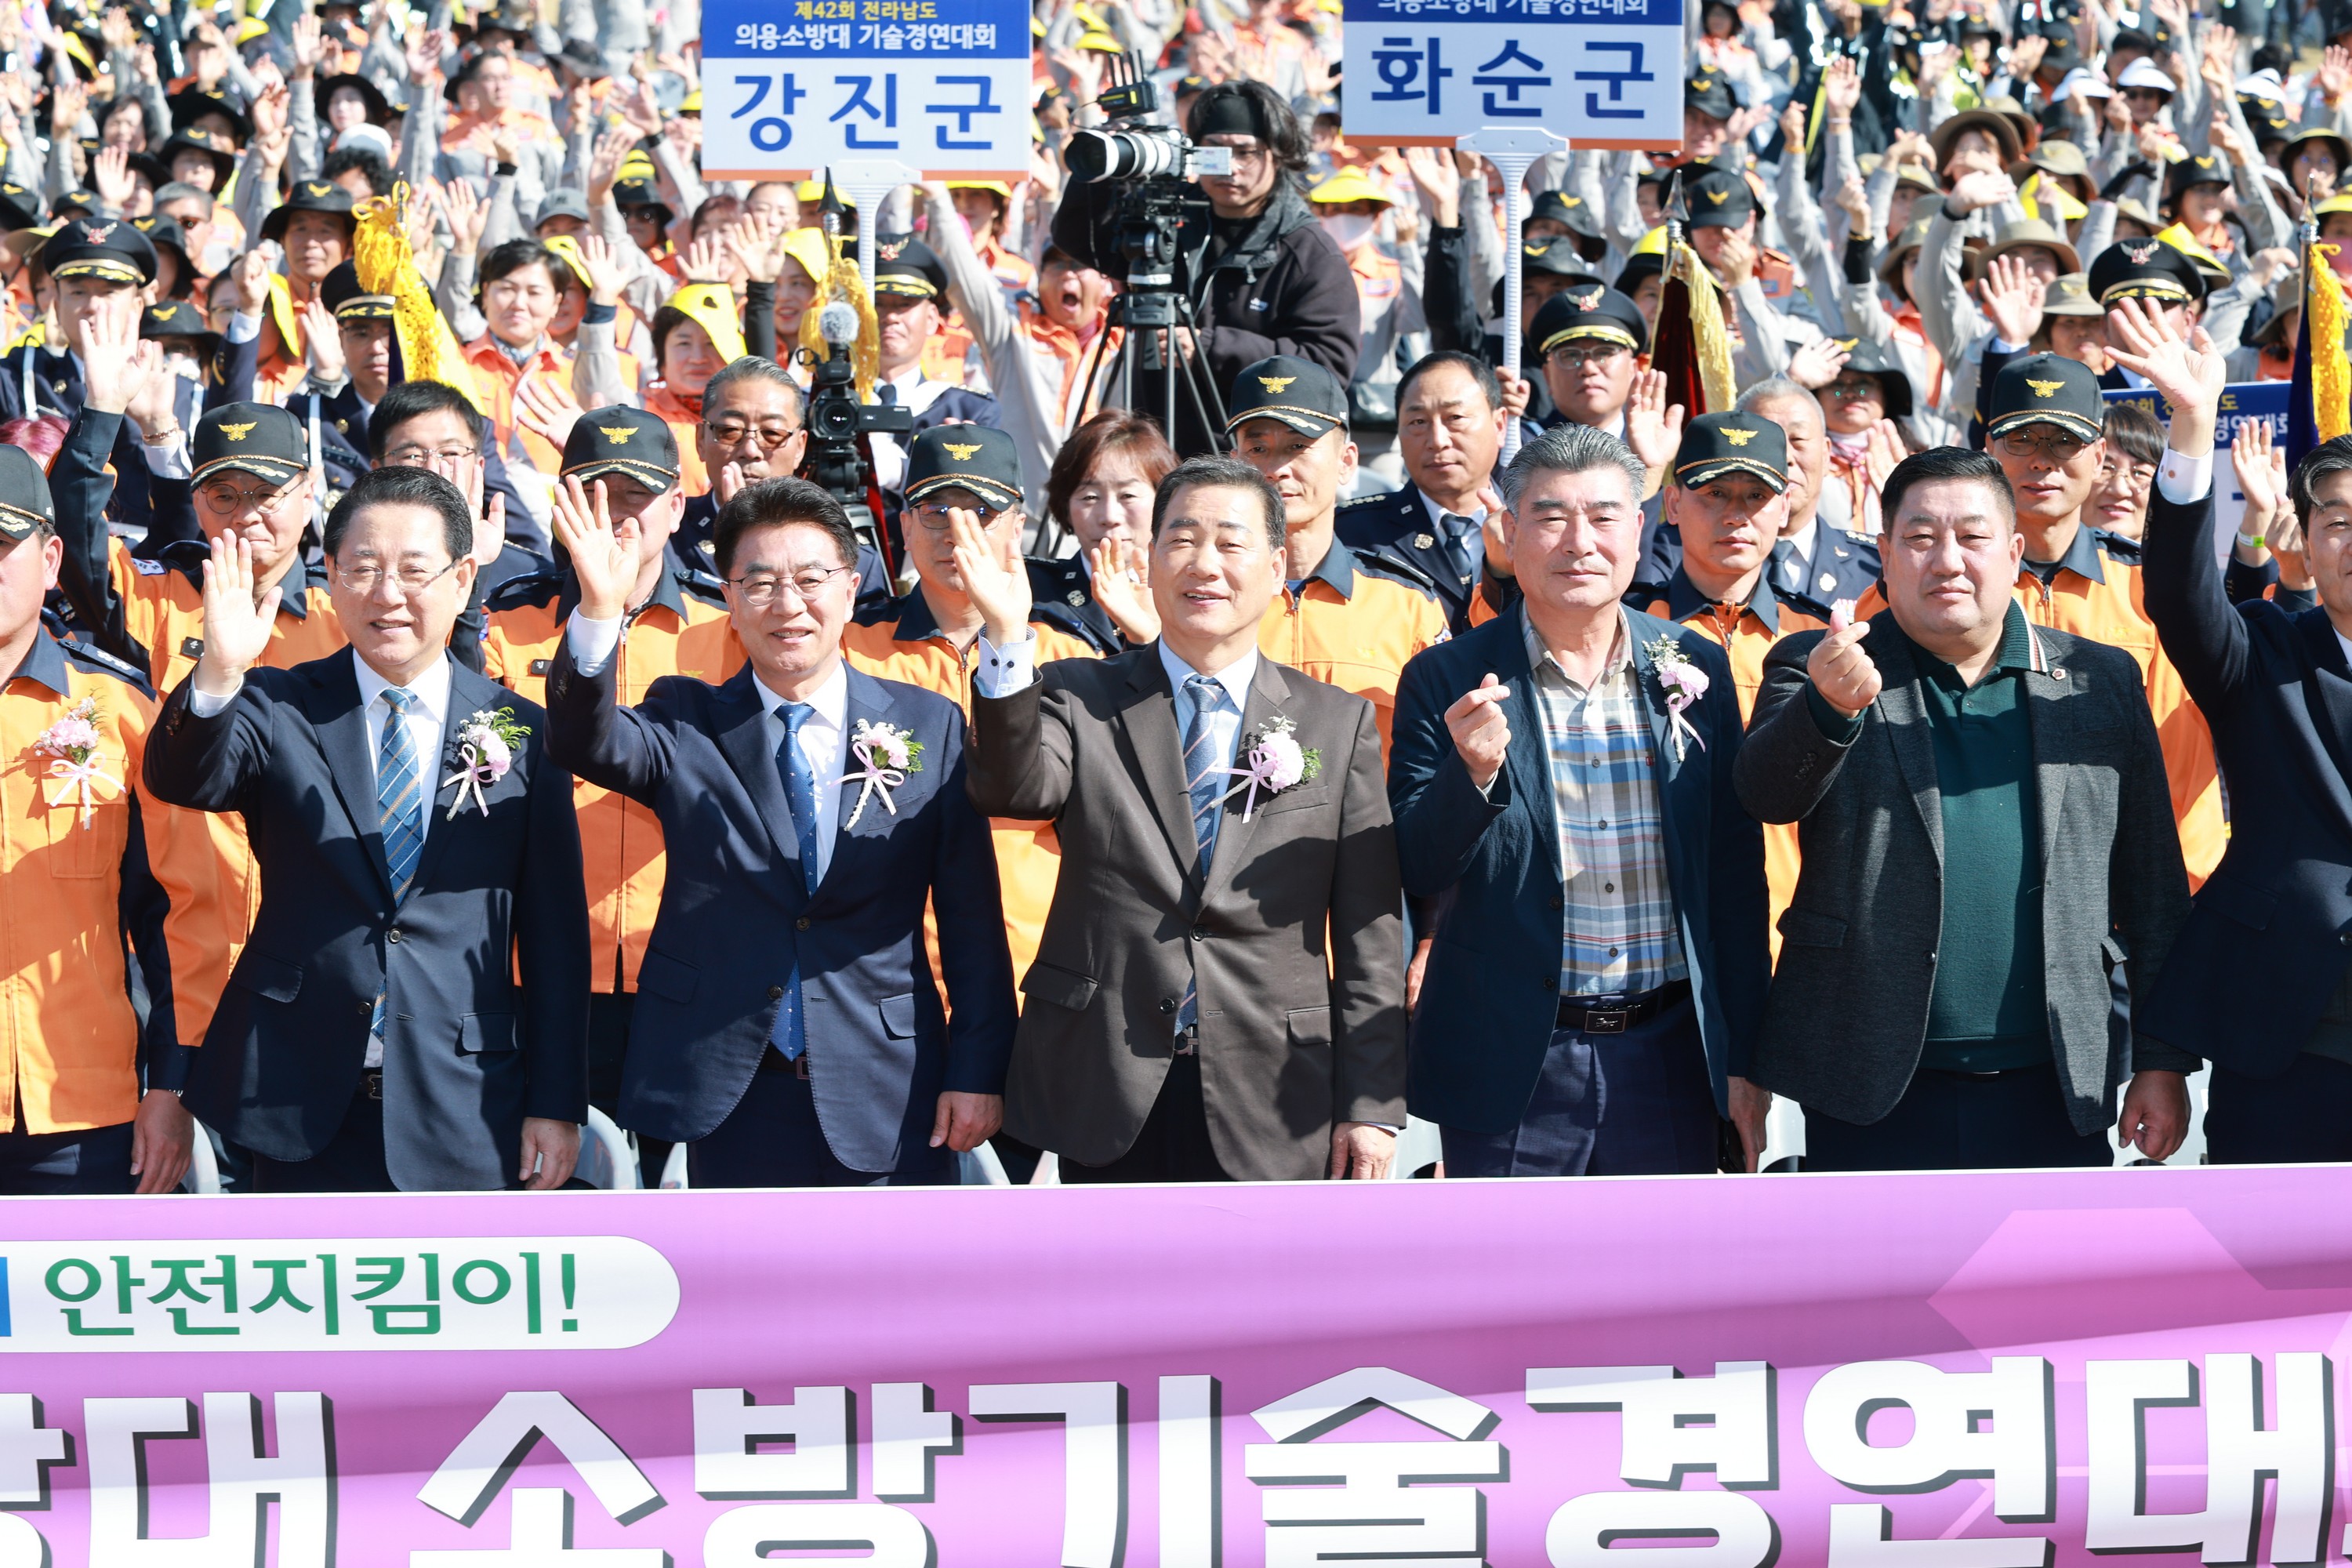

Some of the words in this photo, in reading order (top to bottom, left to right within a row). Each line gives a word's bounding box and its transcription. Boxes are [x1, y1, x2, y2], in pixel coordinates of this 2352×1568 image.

[735, 24, 851, 50] 의용소방대
[858, 24, 996, 50] 기술경연대회
[794, 2, 855, 20] 제42회
[862, 2, 938, 20] 전라남도
[731, 73, 1001, 152] 강진군
[1371, 37, 1654, 118] 화순군
[44, 1252, 579, 1338] 안전지킴이!
[409, 1352, 2352, 1568] 소방기술경연대
